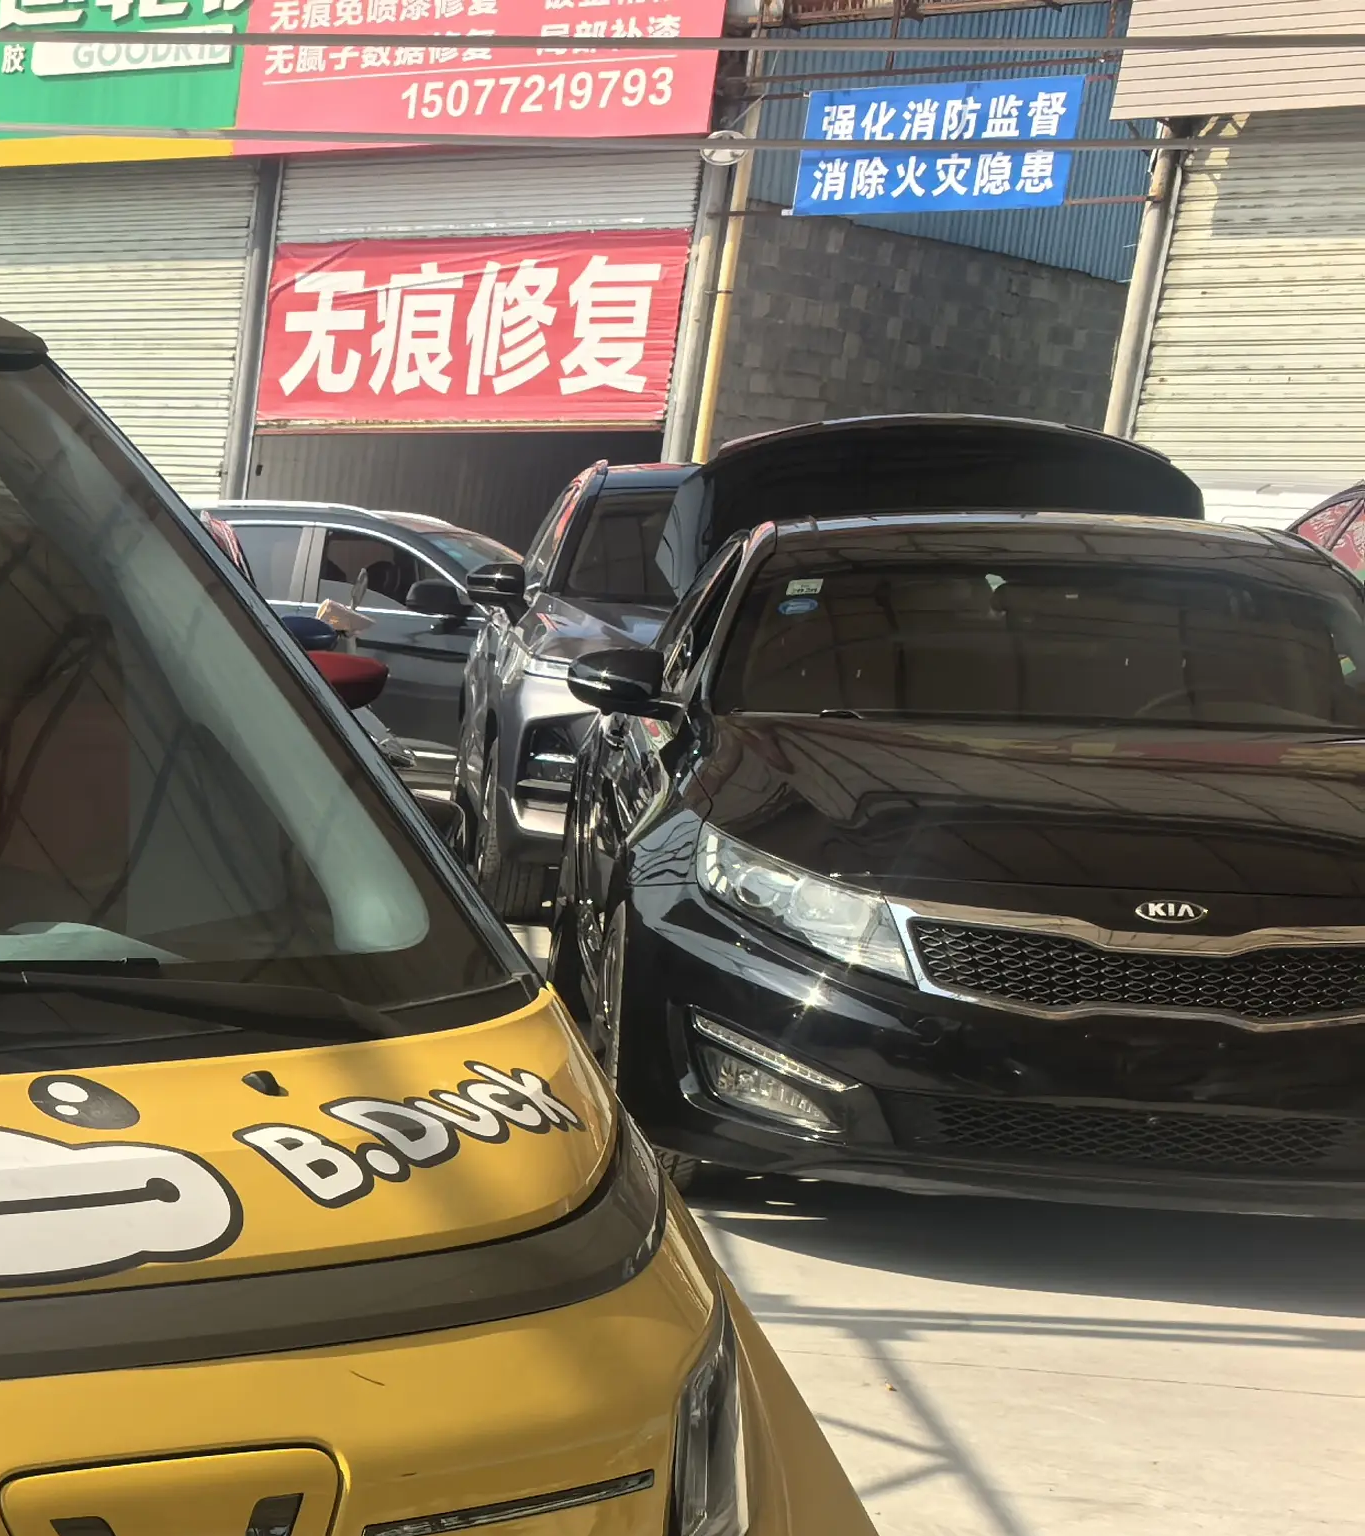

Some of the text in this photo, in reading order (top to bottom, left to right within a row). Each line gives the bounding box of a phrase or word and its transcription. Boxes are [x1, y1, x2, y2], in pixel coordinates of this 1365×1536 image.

[401, 67, 674, 119] 15077219793
[821, 91, 1068, 141] 强化消防监督
[810, 150, 1055, 201] 消除火灾隐患
[278, 255, 662, 397] 无痕修复
[1148, 902, 1195, 917] KIA
[232, 1060, 586, 1208] B.Duck
